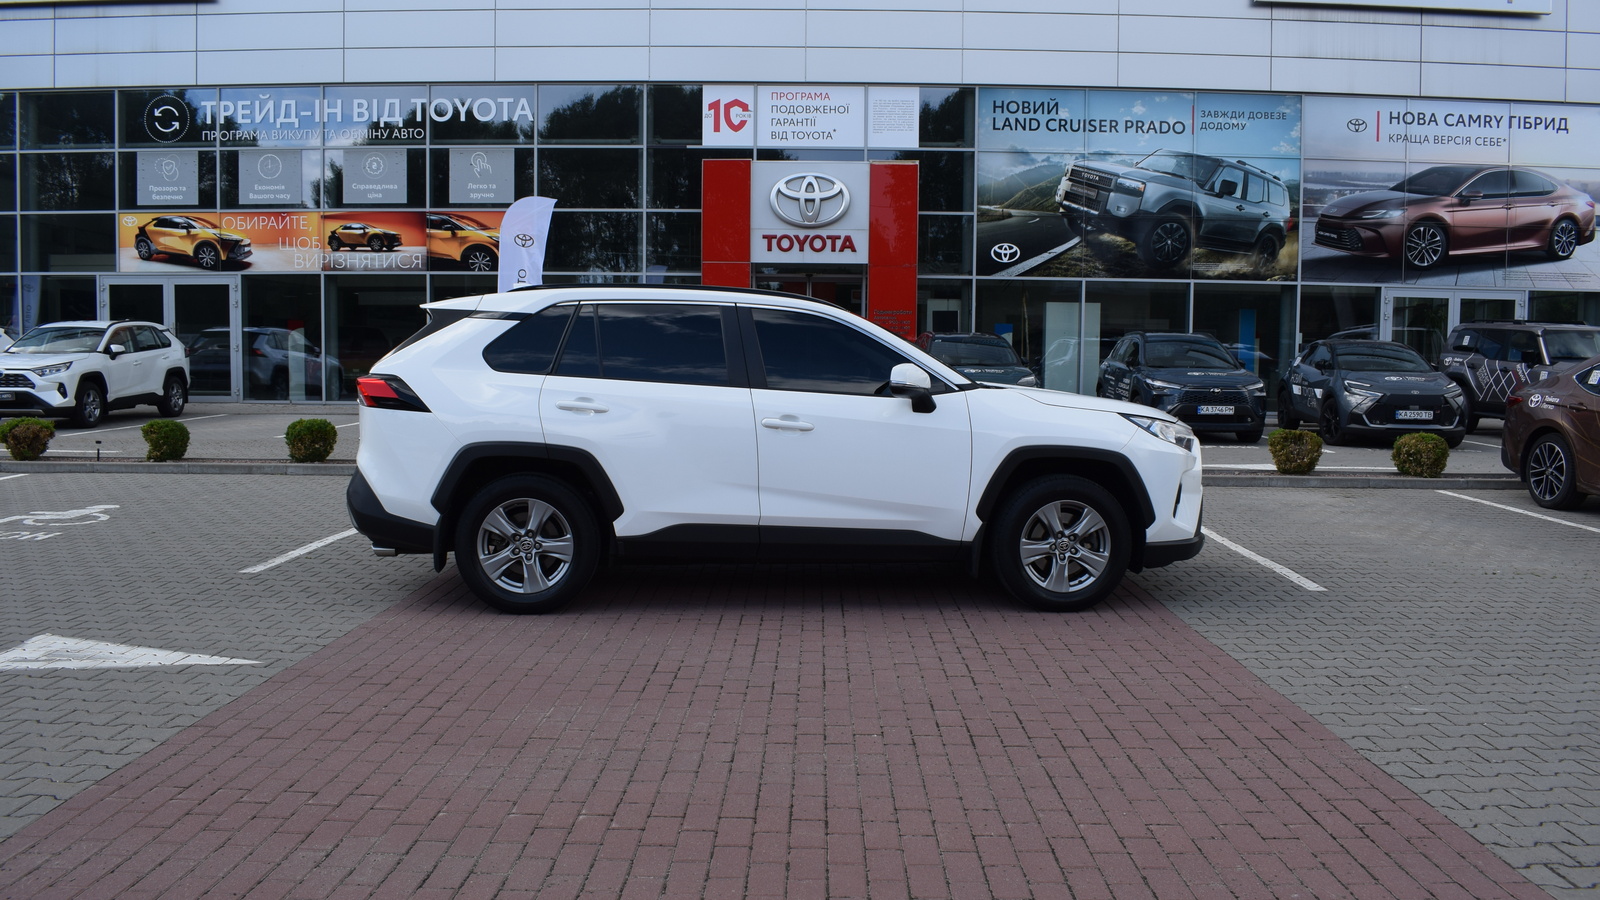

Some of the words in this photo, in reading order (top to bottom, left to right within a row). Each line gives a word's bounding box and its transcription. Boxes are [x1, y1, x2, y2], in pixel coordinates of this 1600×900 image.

[771, 91, 831, 101] ПРОГРАМА
[201, 94, 342, 128] ТРЕЙД-ІН
[353, 98, 403, 127] ВІД
[411, 97, 534, 123] TOYOTA
[771, 103, 850, 115] ПОДОВЖЕНОЇ
[992, 98, 1059, 116] НОВИЙ
[770, 116, 817, 127] ГАРАНТІЇ
[1200, 109, 1244, 122] ЗАВЖДИ
[1247, 111, 1287, 122] ДОВЕЗЕ
[992, 117, 1041, 132] LAND
[1046, 118, 1119, 134] CRUISER
[1124, 120, 1186, 135] PRADO
[1200, 121, 1247, 132] ДОДОМУ
[1388, 111, 1439, 127] НОВА
[1443, 113, 1503, 129] CAMRY
[1508, 115, 1569, 134] ГІБРИД
[202, 129, 268, 142] ПРОГРАМА
[272, 129, 320, 141] ВИКУПУ
[324, 129, 338, 139] ТА
[340, 128, 389, 139] ОБМІНУ
[392, 128, 425, 139] АВТО
[770, 131, 788, 142] ВІД
[1388, 133, 1430, 145] КРАЩА
[1433, 135, 1471, 146] ВЕРСІЯ
[149, 185, 178, 193] Прозоро
[352, 183, 398, 191] Справедлива
[152, 192, 183, 200] безпечно
[249, 192, 274, 200] Вашого
[469, 192, 494, 200] зручно
[222, 213, 313, 232] ОБИРАЙТЕ,
[278, 236, 321, 252] ЩОБ
[762, 234, 857, 253] TOYOTA
[294, 253, 422, 269] ВИРІЗНЯТИСЯ
